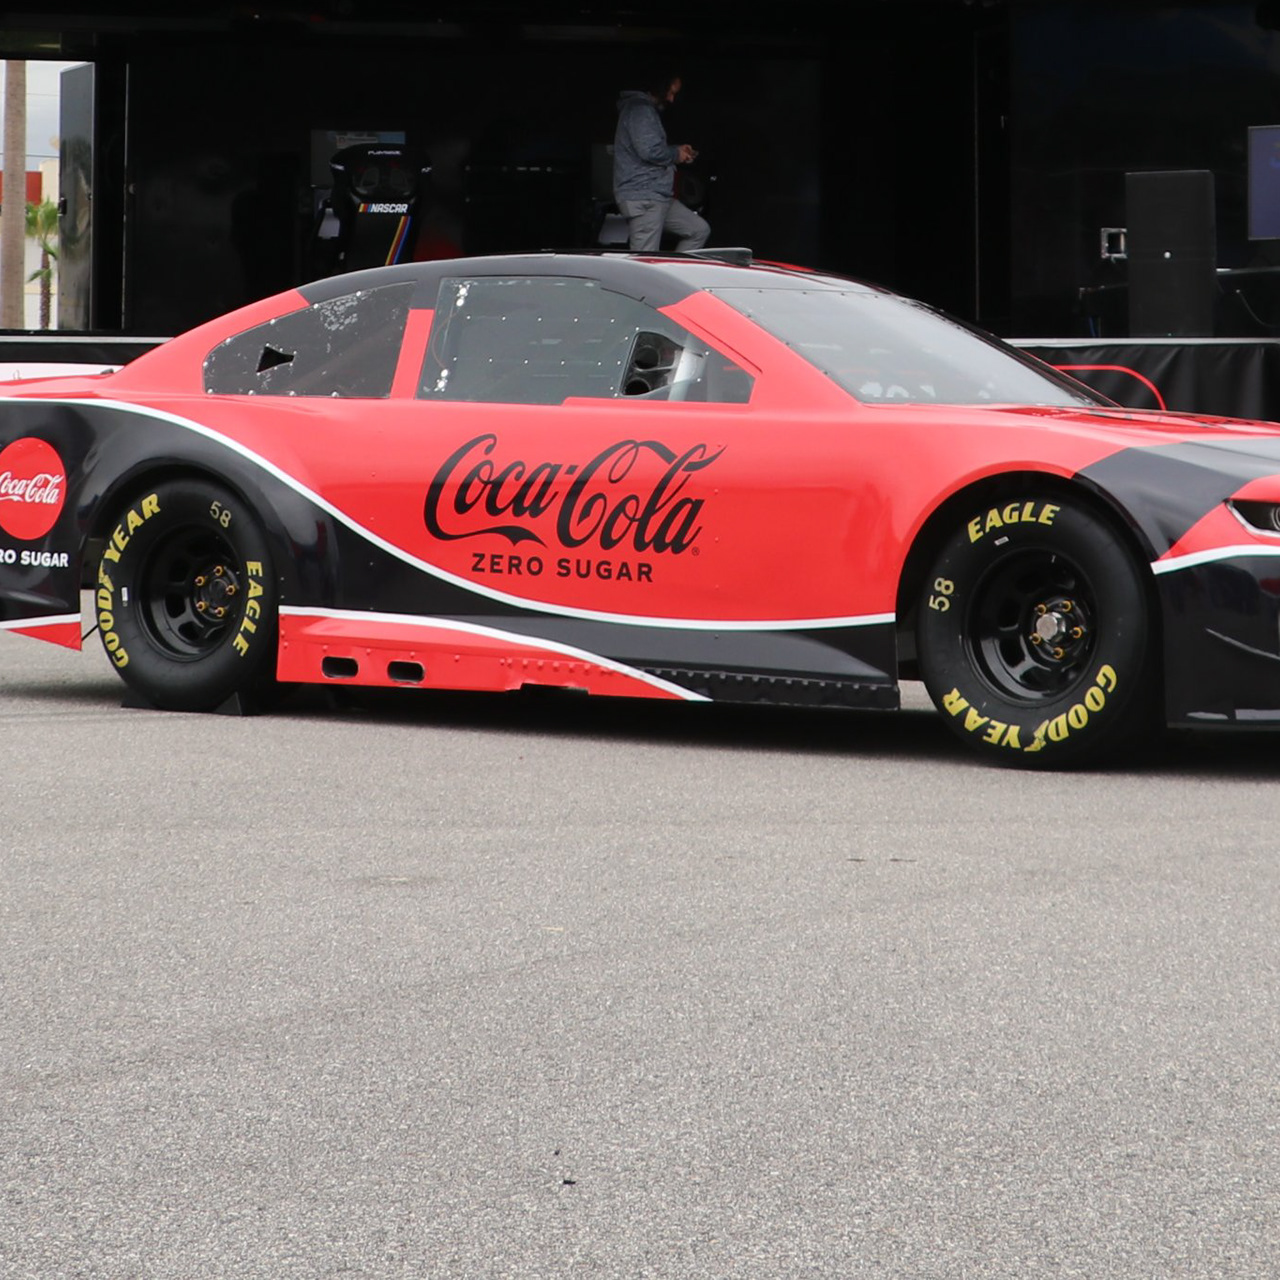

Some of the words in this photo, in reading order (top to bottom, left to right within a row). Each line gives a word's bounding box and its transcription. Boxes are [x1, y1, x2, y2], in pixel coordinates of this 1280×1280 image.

[209, 500, 232, 528] 58
[967, 501, 1060, 543] EAGLE
[20, 549, 69, 568] SUGAR
[472, 553, 544, 576] ZERO
[556, 558, 653, 582] SUGAR
[232, 560, 263, 657] EAGLE
[928, 577, 955, 612] 58
